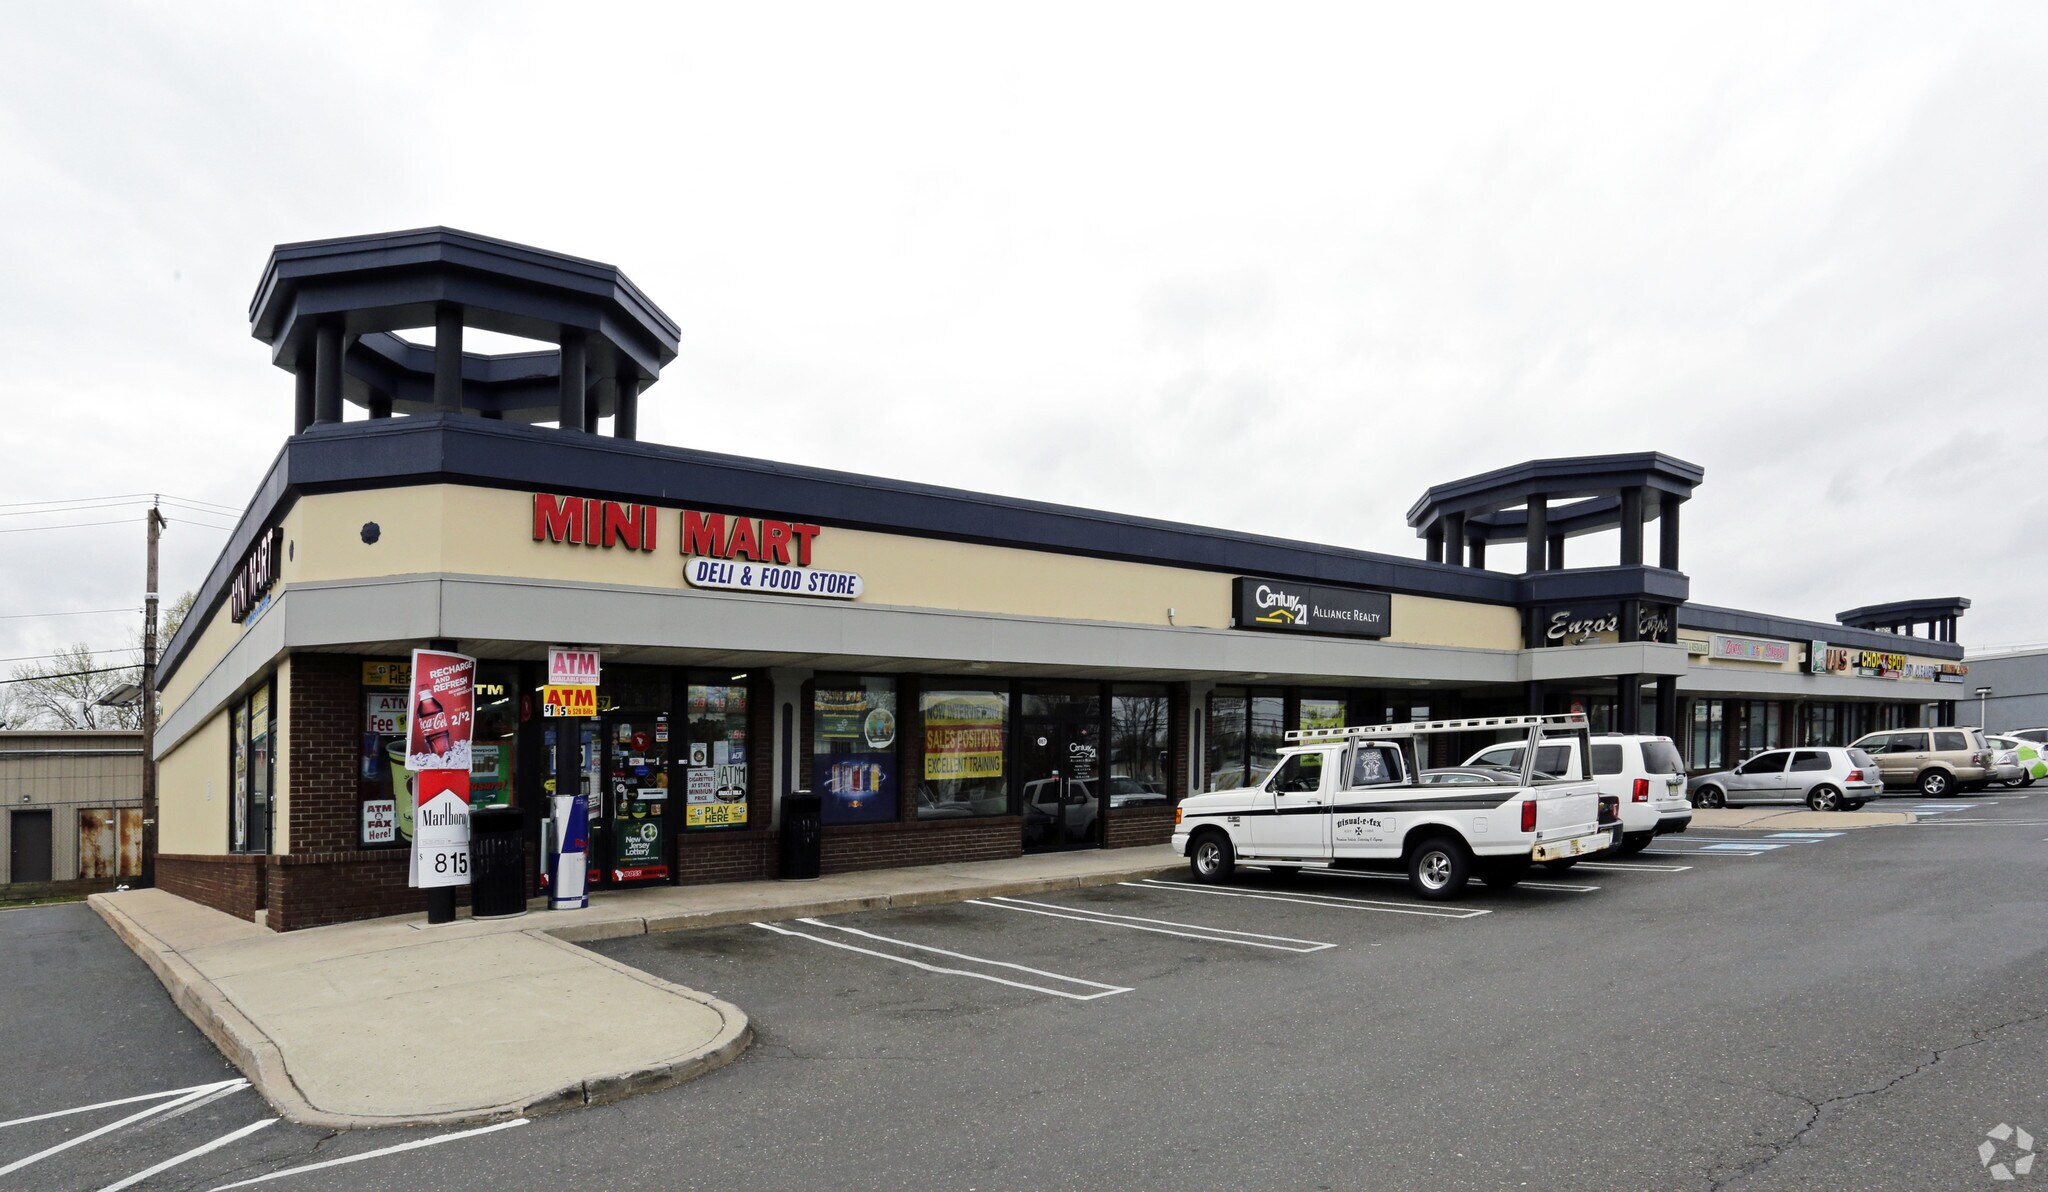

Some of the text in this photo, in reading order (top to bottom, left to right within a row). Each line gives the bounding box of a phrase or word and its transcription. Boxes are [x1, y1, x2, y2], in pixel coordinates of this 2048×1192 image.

[534, 493, 820, 566] MINI MART
[696, 561, 856, 595] DELI & FOOD STORE
[1256, 585, 1307, 625] Century 21
[1547, 610, 1618, 642] Enzo's
[553, 652, 596, 675] ATM
[1862, 651, 1906, 670] CHOP SPOT
[389, 664, 412, 675] PLA
[429, 661, 472, 679] RECHARGE
[389, 674, 412, 684] HER
[433, 676, 468, 693] REFRESH
[435, 676, 450, 684] AND
[474, 684, 504, 695] TM
[547, 689, 594, 706] ATM
[371, 715, 393, 732] Fee
[928, 729, 1000, 749] SALES POSITIONS
[928, 755, 1000, 774] EXCELLENT TRAINING
[366, 804, 393, 813] ATM
[423, 802, 467, 827] Marlboro
[705, 806, 730, 814] PLAY
[367, 820, 392, 828] FAX
[705, 814, 729, 823] HERE
[368, 828, 392, 840] Here!
[625, 836, 641, 844] New
[625, 848, 650, 857] Lottery
[629, 842, 651, 851] Jersey
